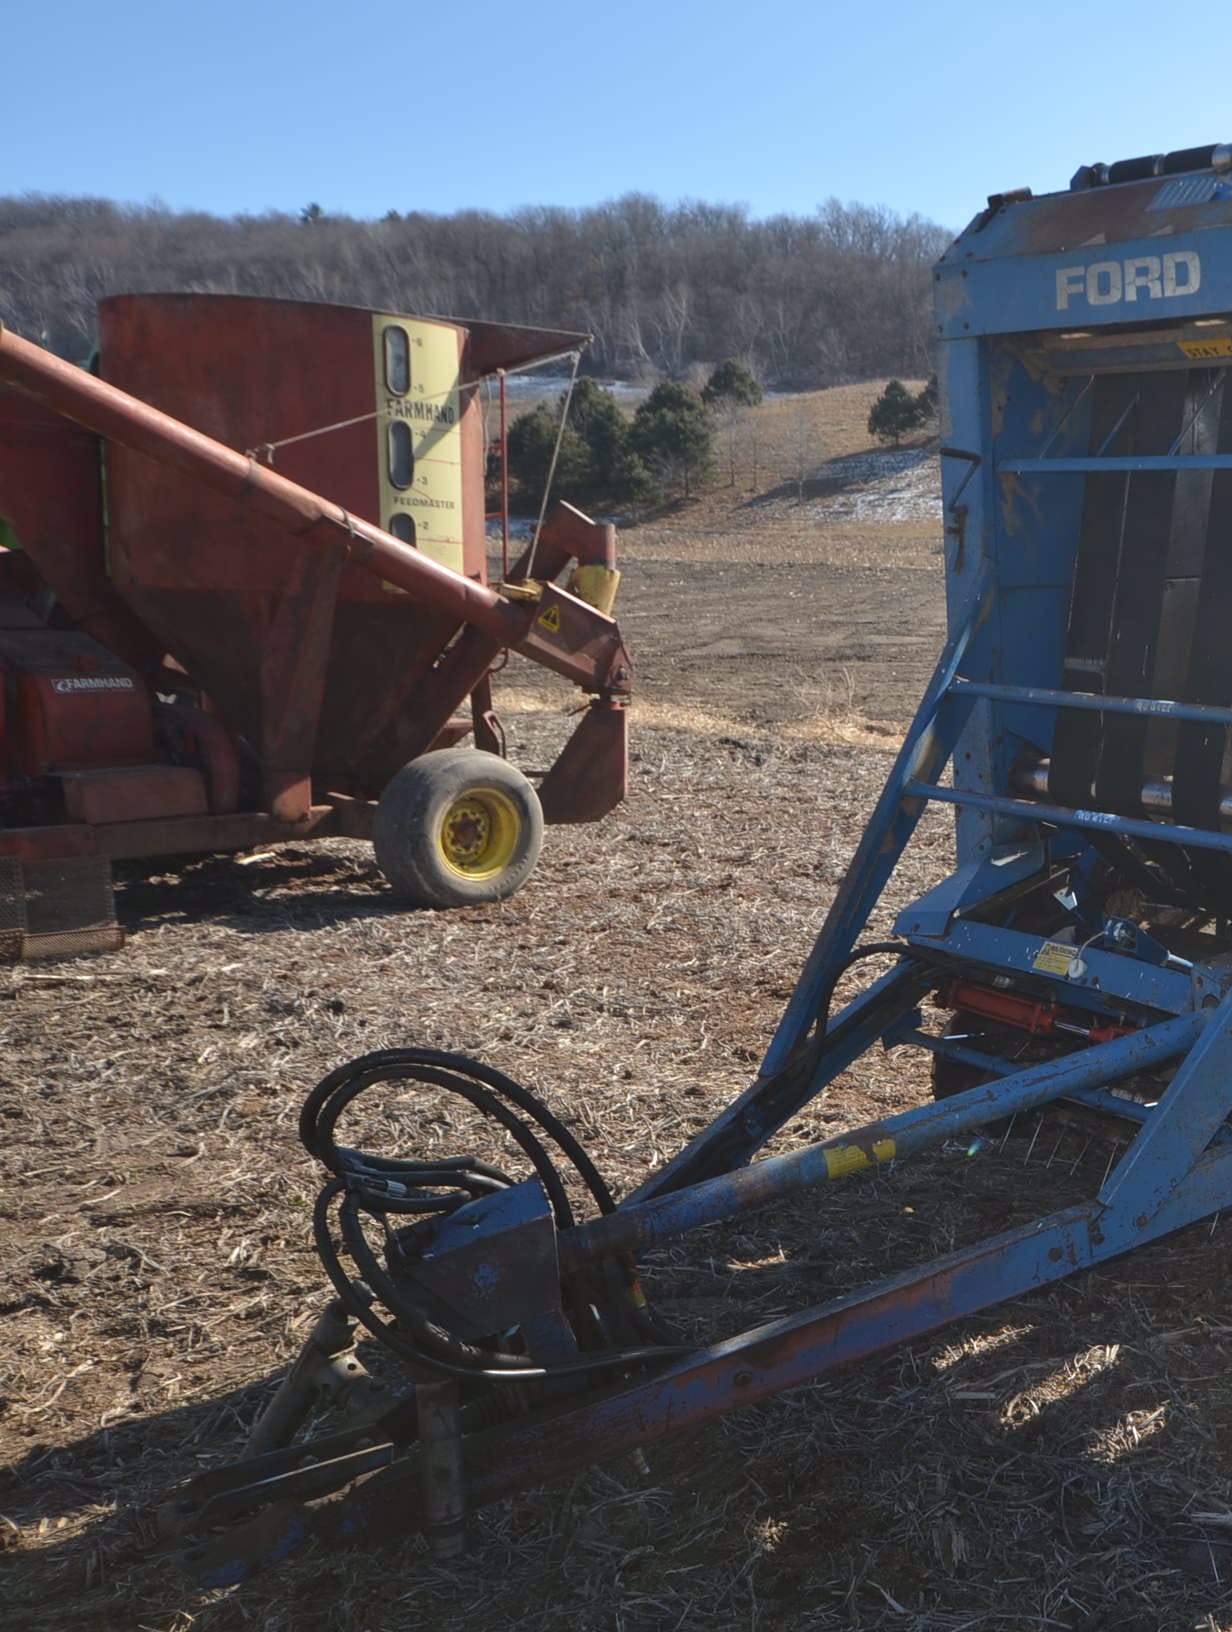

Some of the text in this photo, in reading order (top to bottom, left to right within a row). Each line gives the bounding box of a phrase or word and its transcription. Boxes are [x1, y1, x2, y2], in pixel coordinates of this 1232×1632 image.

[1056, 250, 1200, 311] FORD
[386, 398, 456, 425] FARMHAND
[393, 497, 455, 510] FEEDMASTER
[63, 677, 134, 689] FARMHAND
